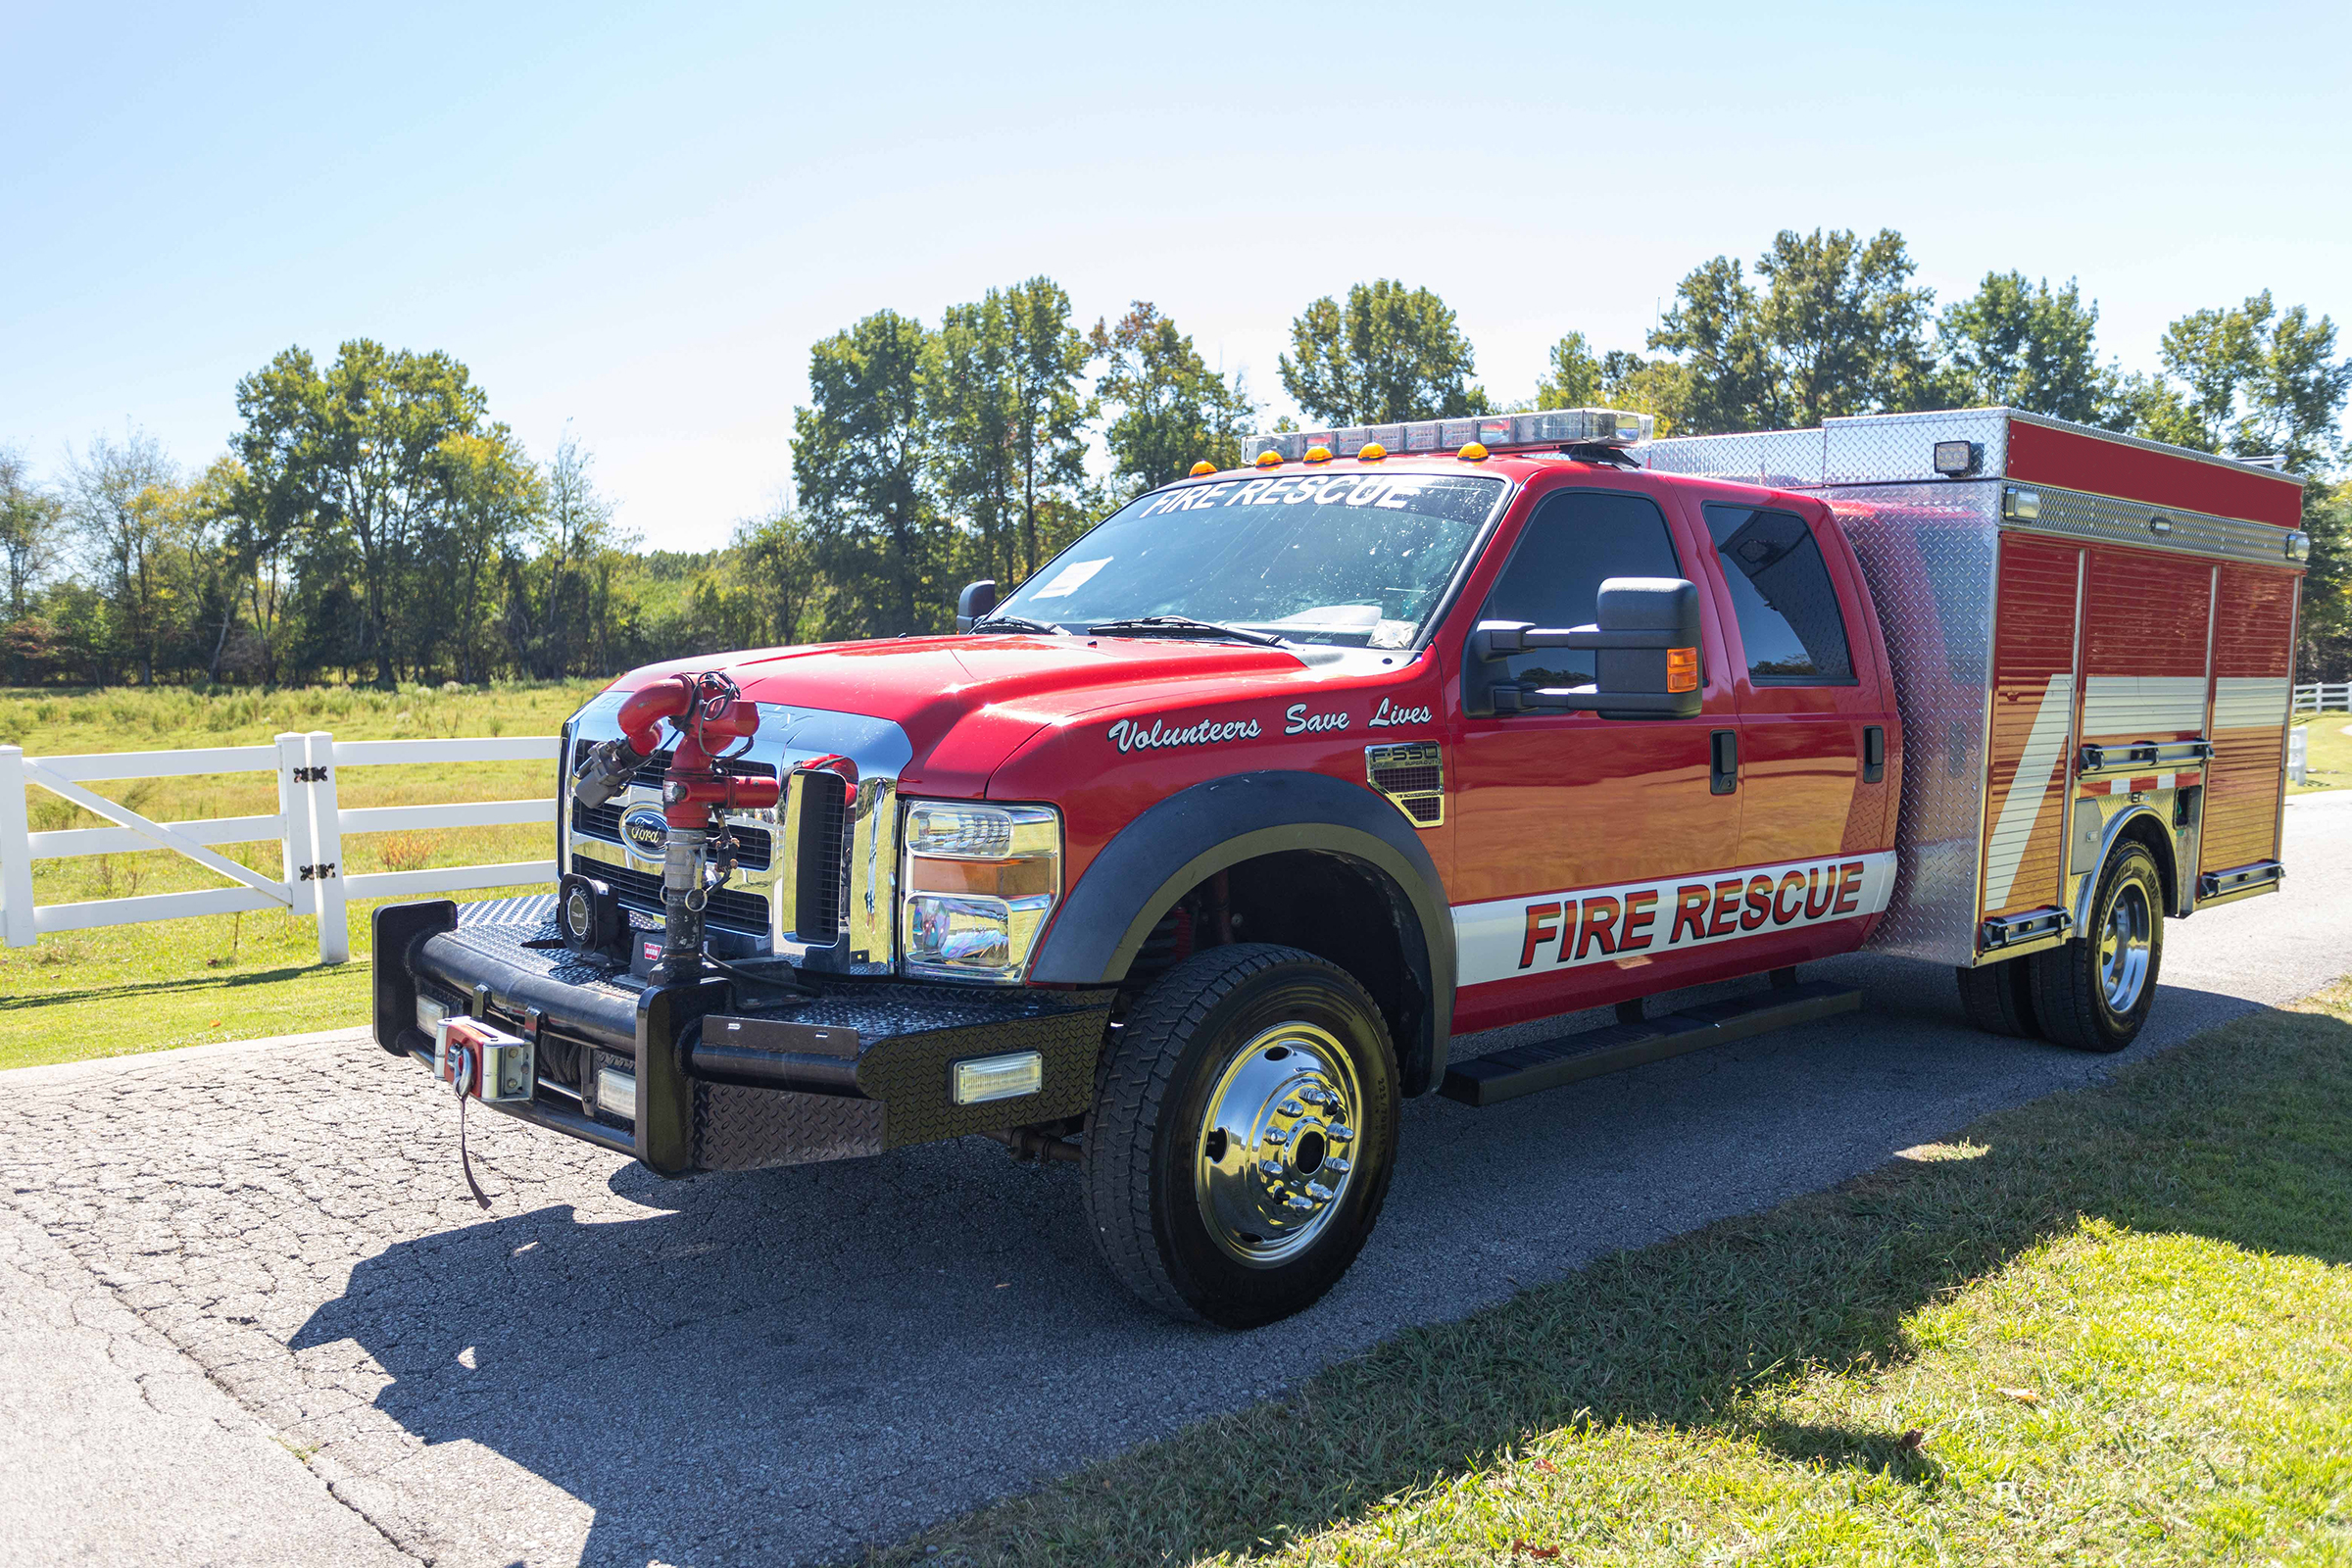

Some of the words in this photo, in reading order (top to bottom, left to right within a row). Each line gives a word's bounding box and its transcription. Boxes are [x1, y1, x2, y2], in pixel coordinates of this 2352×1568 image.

[1139, 481, 1240, 518] FIRE
[1225, 474, 1427, 509] RESCUE
[1107, 718, 1261, 755] Volunteers
[1284, 703, 1349, 734] Save
[1368, 697, 1432, 728] Lives
[1372, 746, 1439, 762] F-550
[631, 816, 661, 844] Ford
[1518, 889, 1658, 969] FIRE
[1669, 861, 1864, 945] RESCUE
